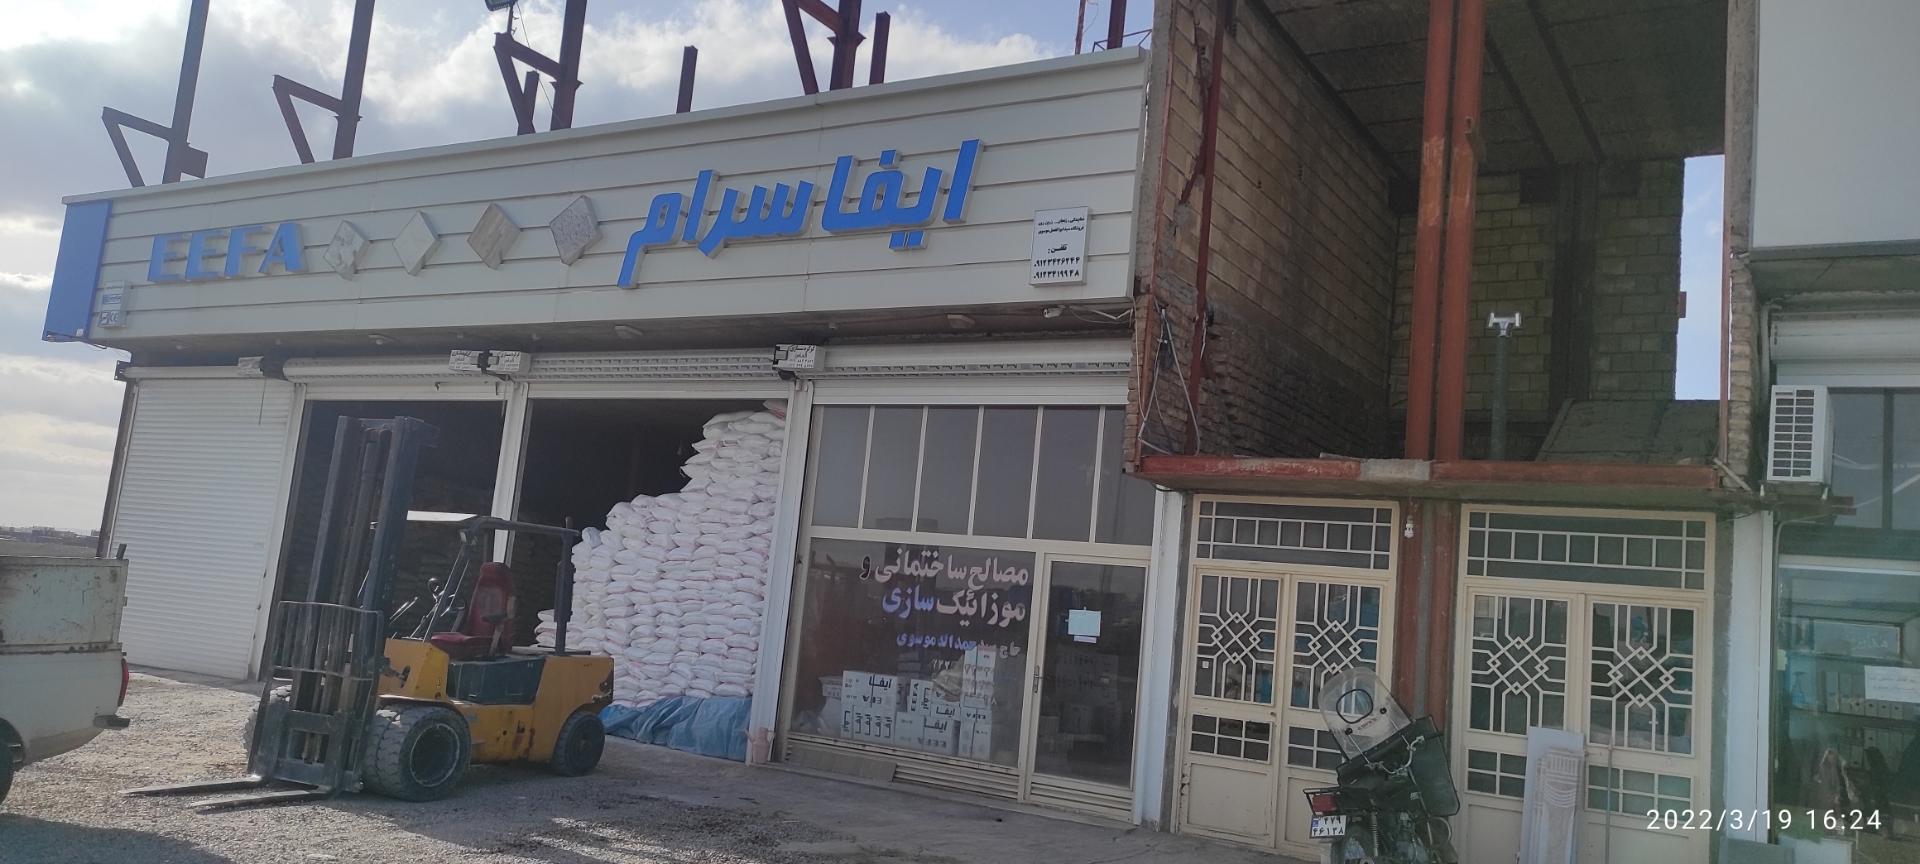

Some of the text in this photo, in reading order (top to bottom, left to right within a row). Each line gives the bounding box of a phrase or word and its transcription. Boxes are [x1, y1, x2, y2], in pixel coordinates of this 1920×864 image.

[617, 138, 985, 290] ایفا سرام
[147, 222, 308, 284] EEFA
[858, 548, 1029, 590] مصالح ساختمانی و
[882, 585, 1027, 628] موزائیک سازی
